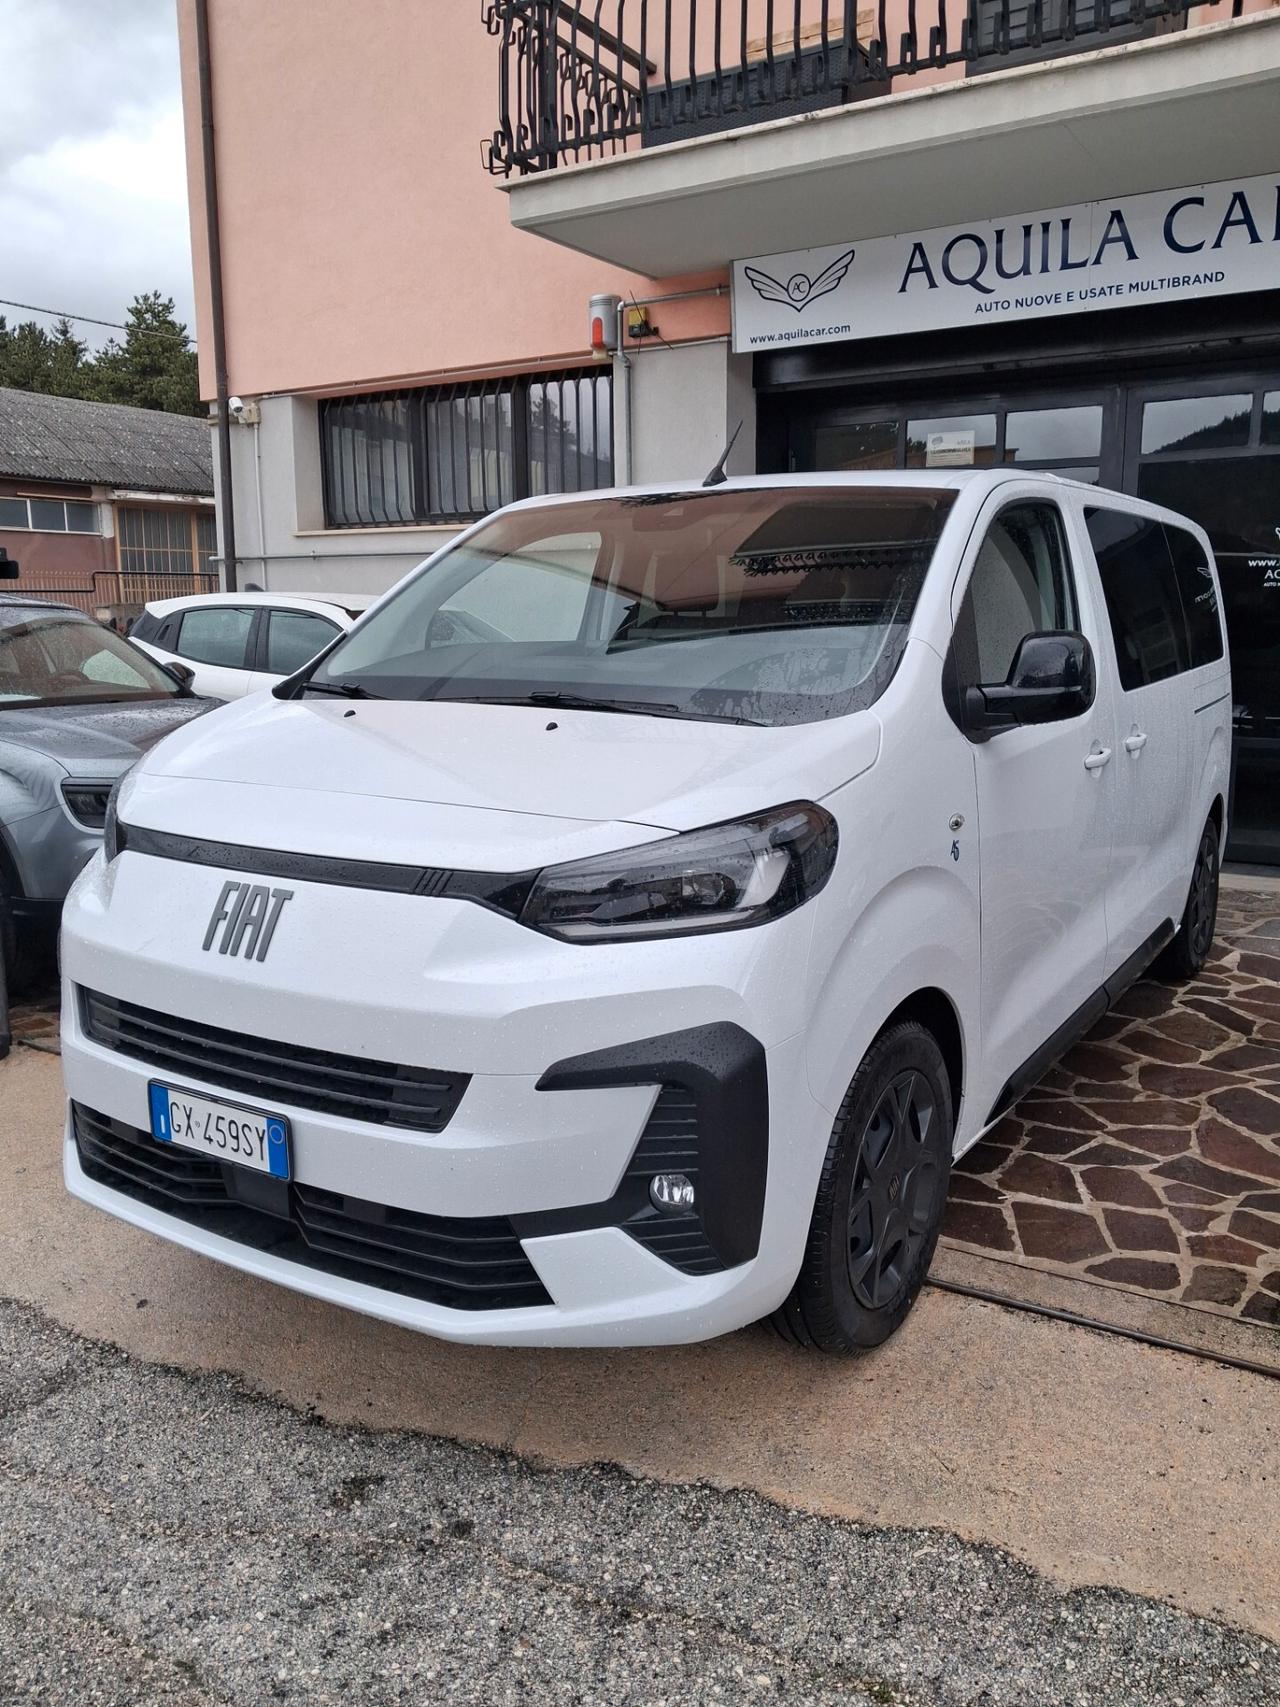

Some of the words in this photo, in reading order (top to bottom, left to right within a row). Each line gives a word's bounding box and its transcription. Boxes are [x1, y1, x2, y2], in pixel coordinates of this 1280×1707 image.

[898, 209, 1140, 295] AQUILA
[1163, 185, 1280, 254] CA
[791, 280, 806, 295] AC
[974, 300, 1011, 314] AUTO
[1015, 292, 1062, 309] NUOVE
[1066, 290, 1075, 303] E
[1079, 284, 1124, 301] USATE
[1128, 270, 1226, 294] MULTIBRAND
[749, 324, 851, 345] www.aquilacar.com
[1248, 559, 1280, 567] www.
[202, 880, 295, 963] FIAT
